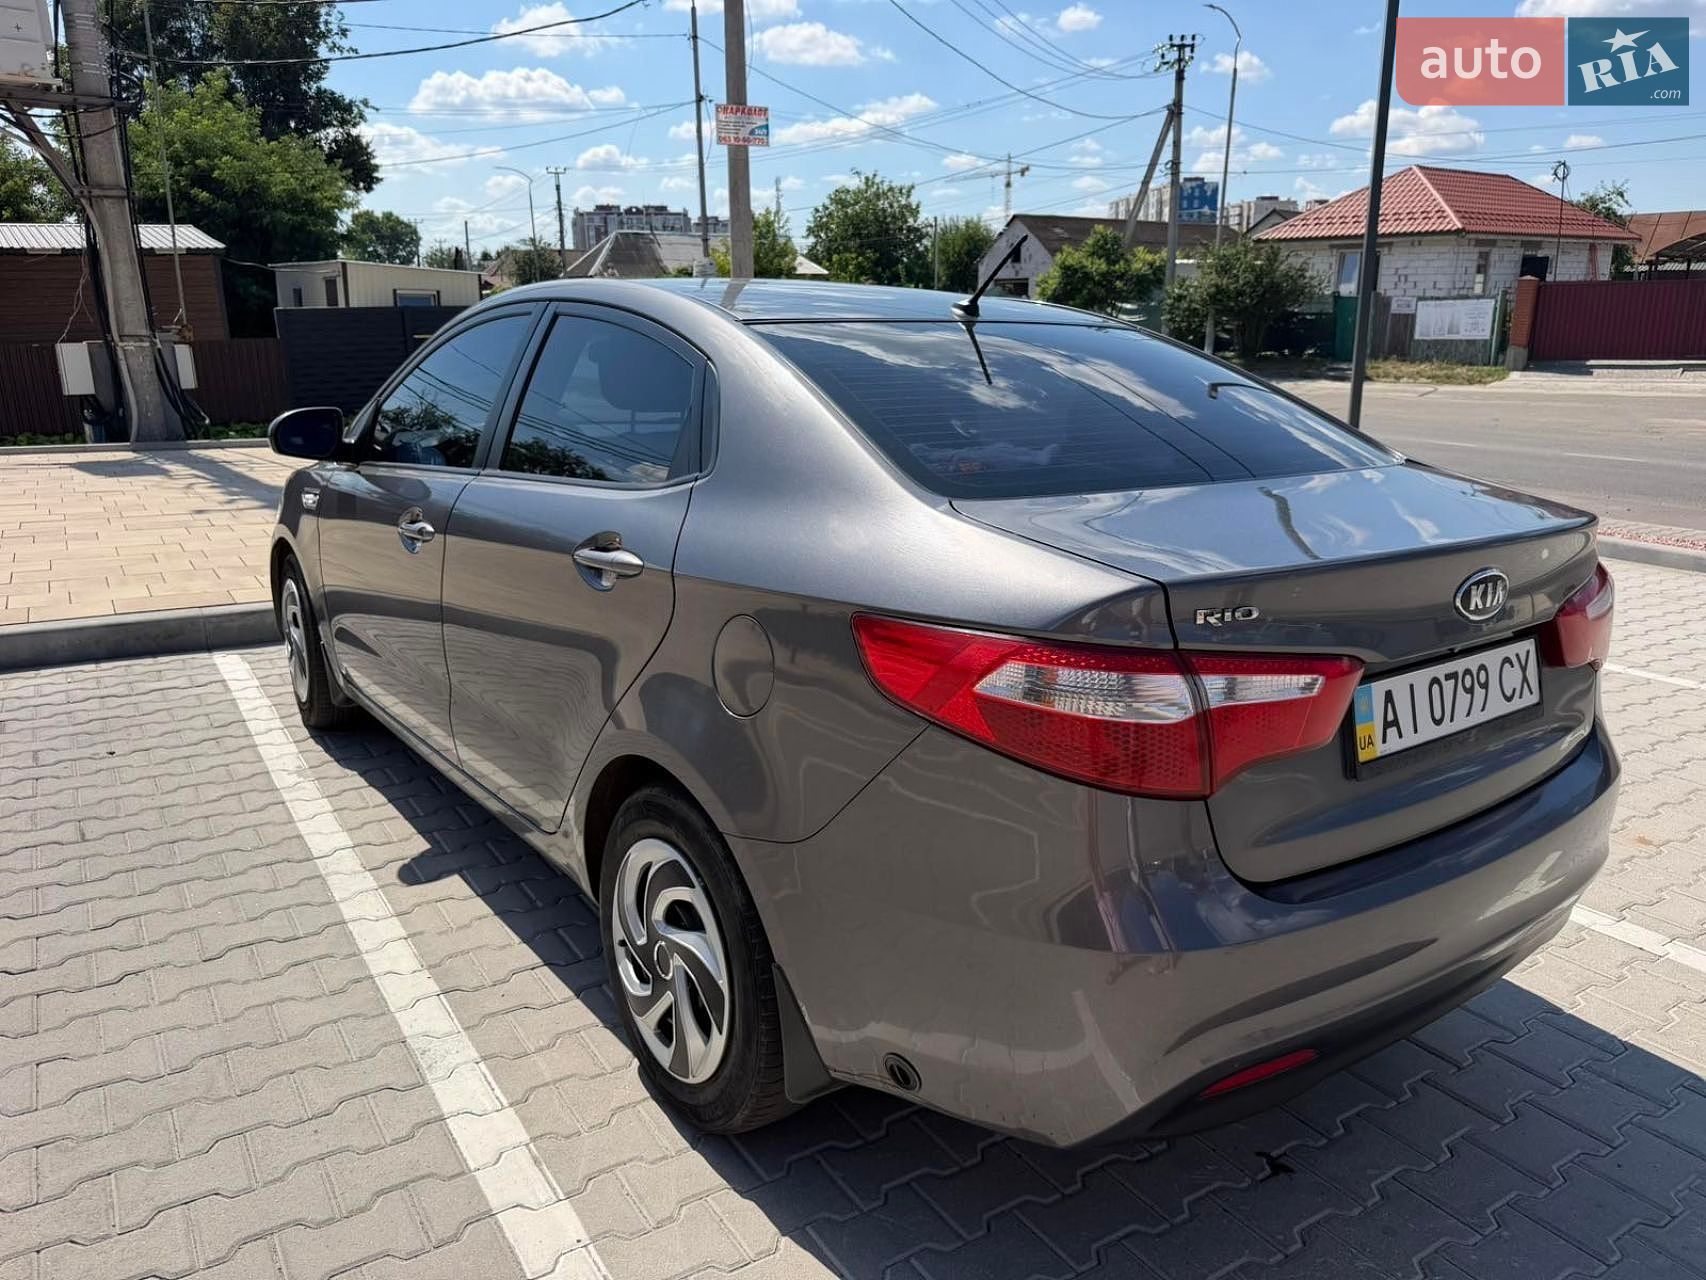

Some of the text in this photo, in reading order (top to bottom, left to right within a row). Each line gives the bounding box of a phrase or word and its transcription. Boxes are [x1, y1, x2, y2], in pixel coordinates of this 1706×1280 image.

[1469, 580, 1503, 610] KIA
[1196, 606, 1260, 627] RIO
[1382, 648, 1534, 744] AI 0799 CX
[1359, 734, 1374, 751] UA
